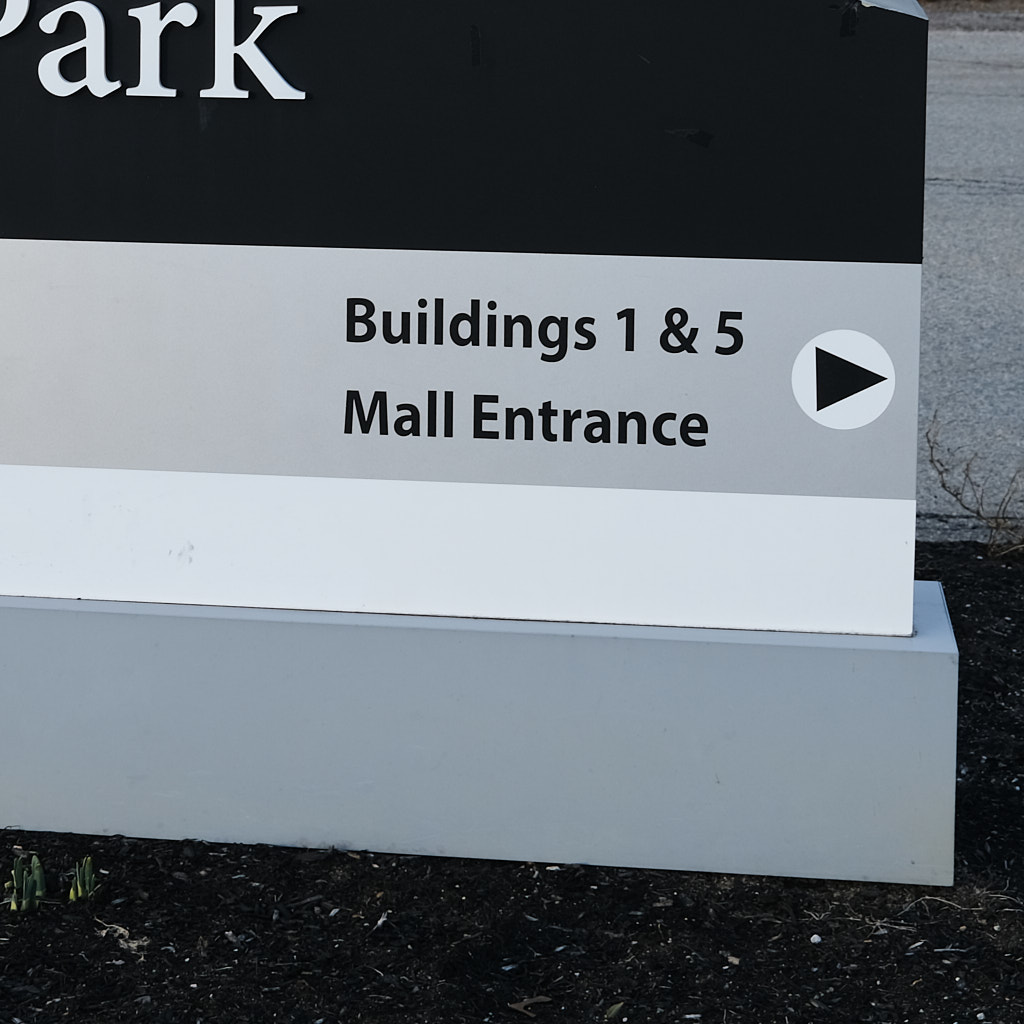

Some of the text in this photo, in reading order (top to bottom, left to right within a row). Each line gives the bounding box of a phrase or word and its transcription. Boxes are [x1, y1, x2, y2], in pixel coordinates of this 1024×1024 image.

[346, 297, 744, 363] Buildings 1 & 5
[343, 389, 709, 448] Mall Entrance
